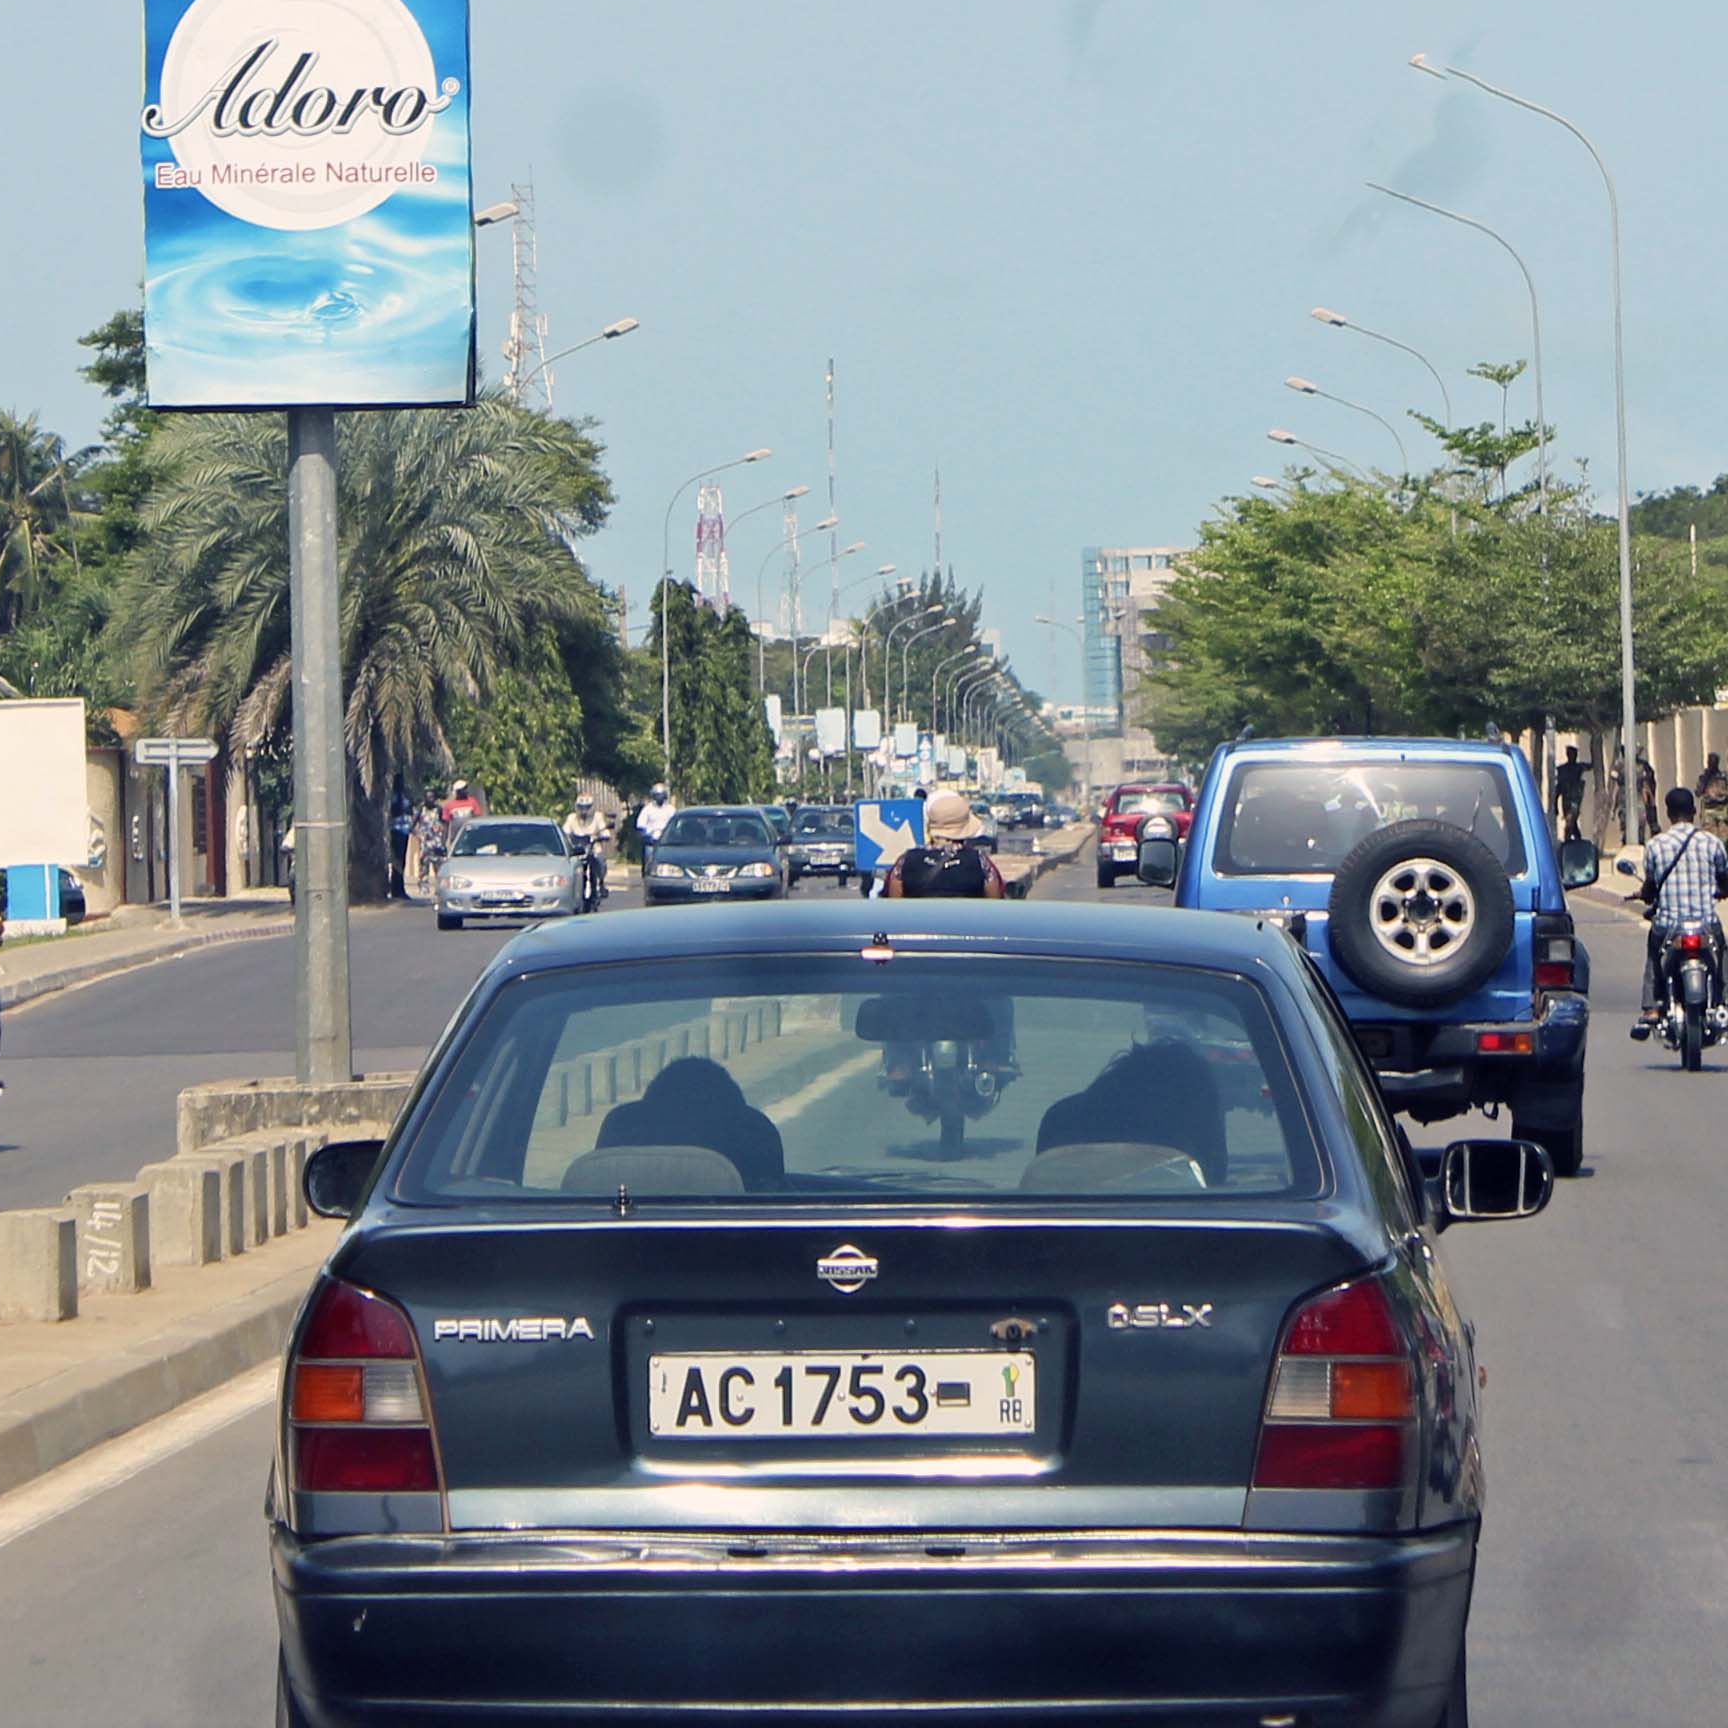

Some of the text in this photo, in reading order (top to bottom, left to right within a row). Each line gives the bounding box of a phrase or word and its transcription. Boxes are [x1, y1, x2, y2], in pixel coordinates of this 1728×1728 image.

[144, 37, 449, 136] Adoro
[156, 161, 437, 186] Eau Minérale Naturelle
[434, 1316, 595, 1341] PRIMERA
[675, 1364, 929, 1427] AC 1753
[999, 1398, 1023, 1424] RB
